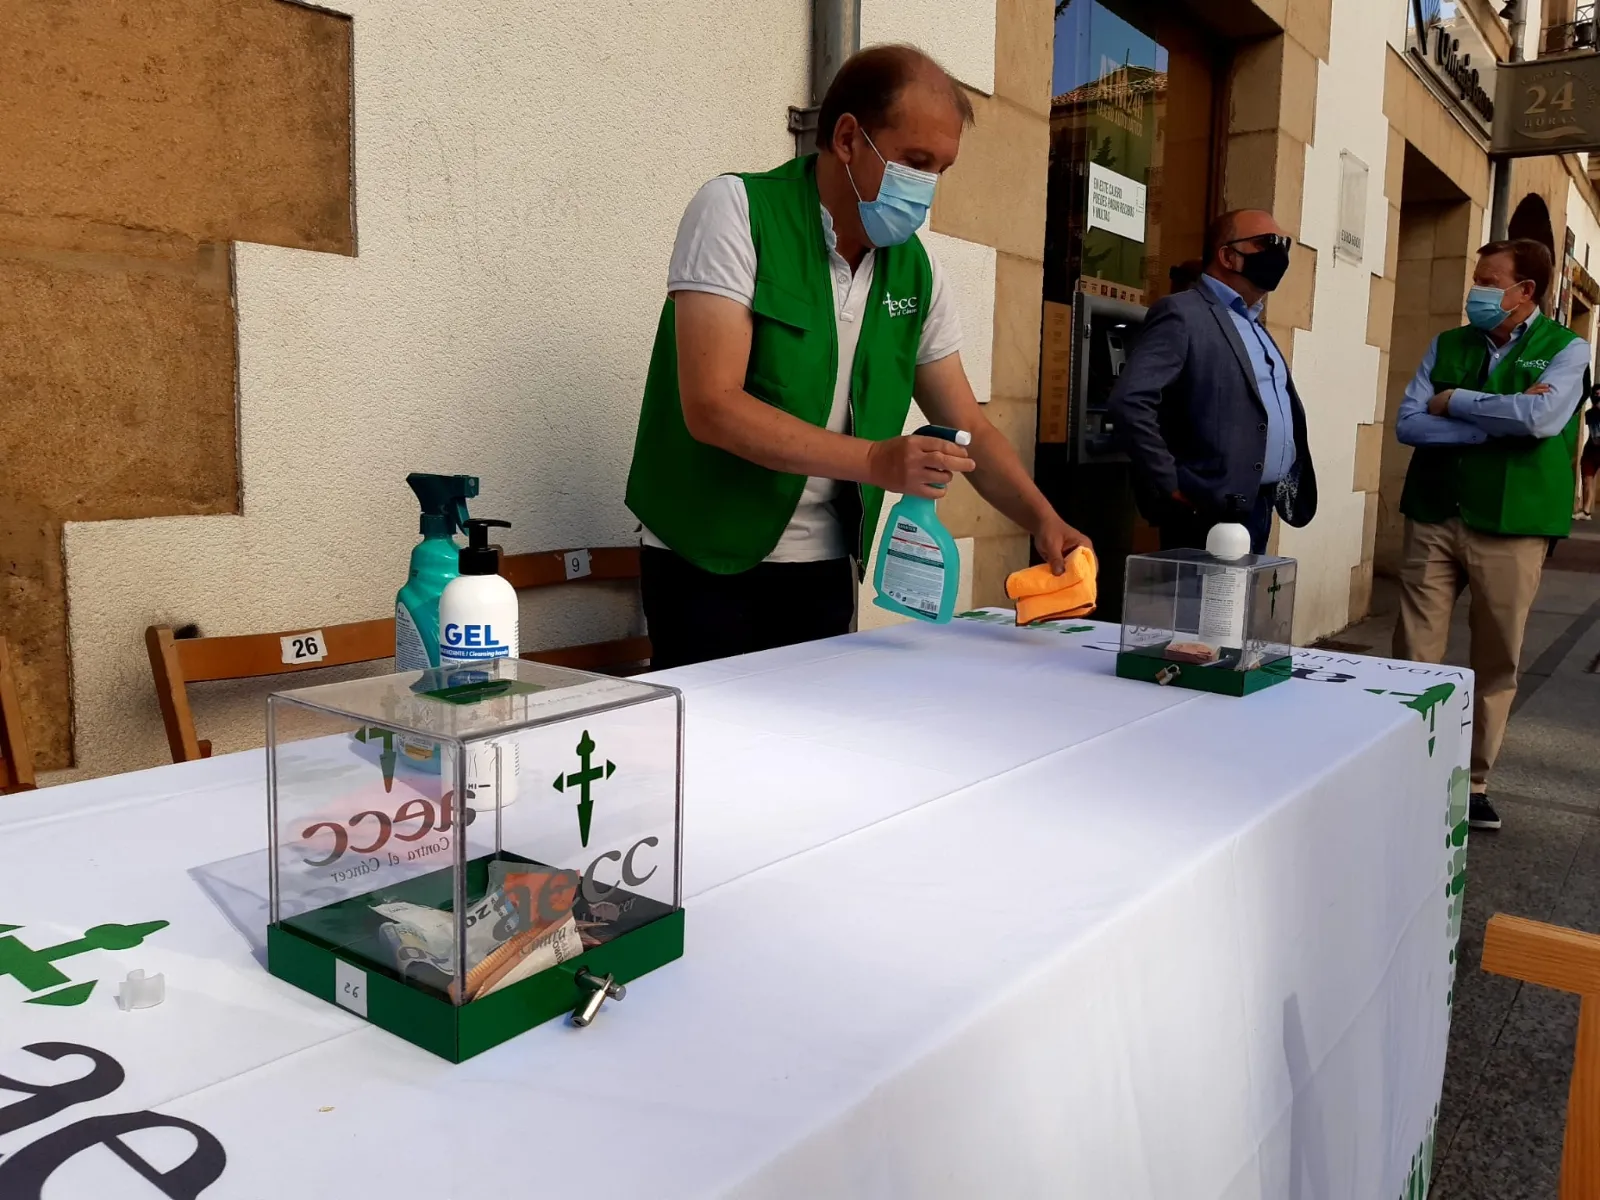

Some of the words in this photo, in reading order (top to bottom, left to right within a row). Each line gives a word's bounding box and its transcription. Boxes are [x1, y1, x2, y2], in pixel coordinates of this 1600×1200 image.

[1523, 82, 1576, 115] 24
[571, 557, 580, 573] 9
[445, 623, 499, 646] GEL
[292, 636, 319, 659] 26
[493, 836, 659, 942] aecc
